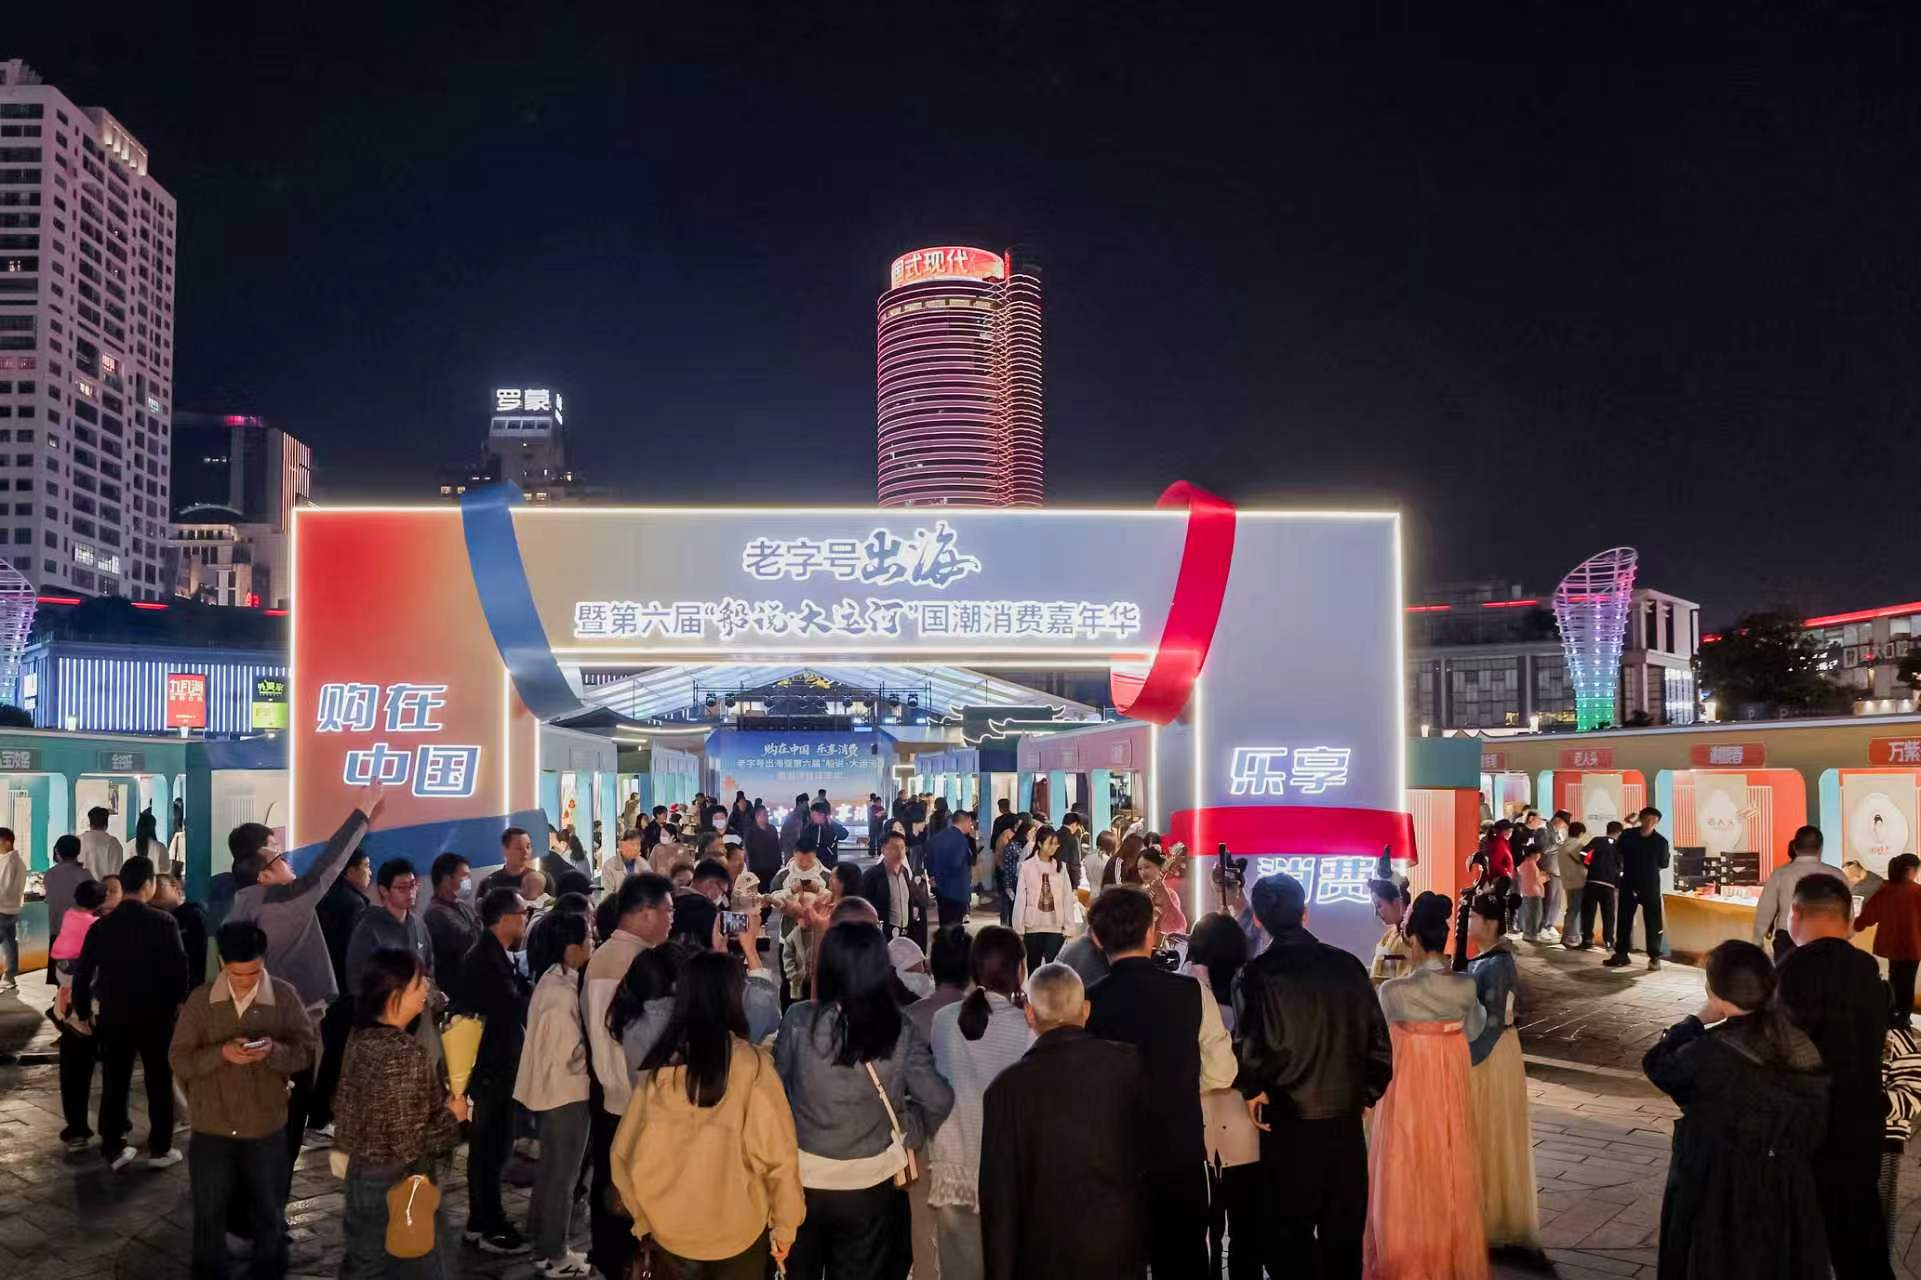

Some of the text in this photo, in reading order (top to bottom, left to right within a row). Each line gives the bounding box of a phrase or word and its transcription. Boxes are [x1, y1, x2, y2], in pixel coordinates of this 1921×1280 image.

[496, 388, 552, 411] 罗蒙
[744, 522, 980, 587] 老字号出海
[316, 683, 448, 732] 购在
[344, 742, 481, 797] 中国
[763, 743, 859, 759] 购在中国 乐享消费
[1230, 746, 1351, 795] 乐享
